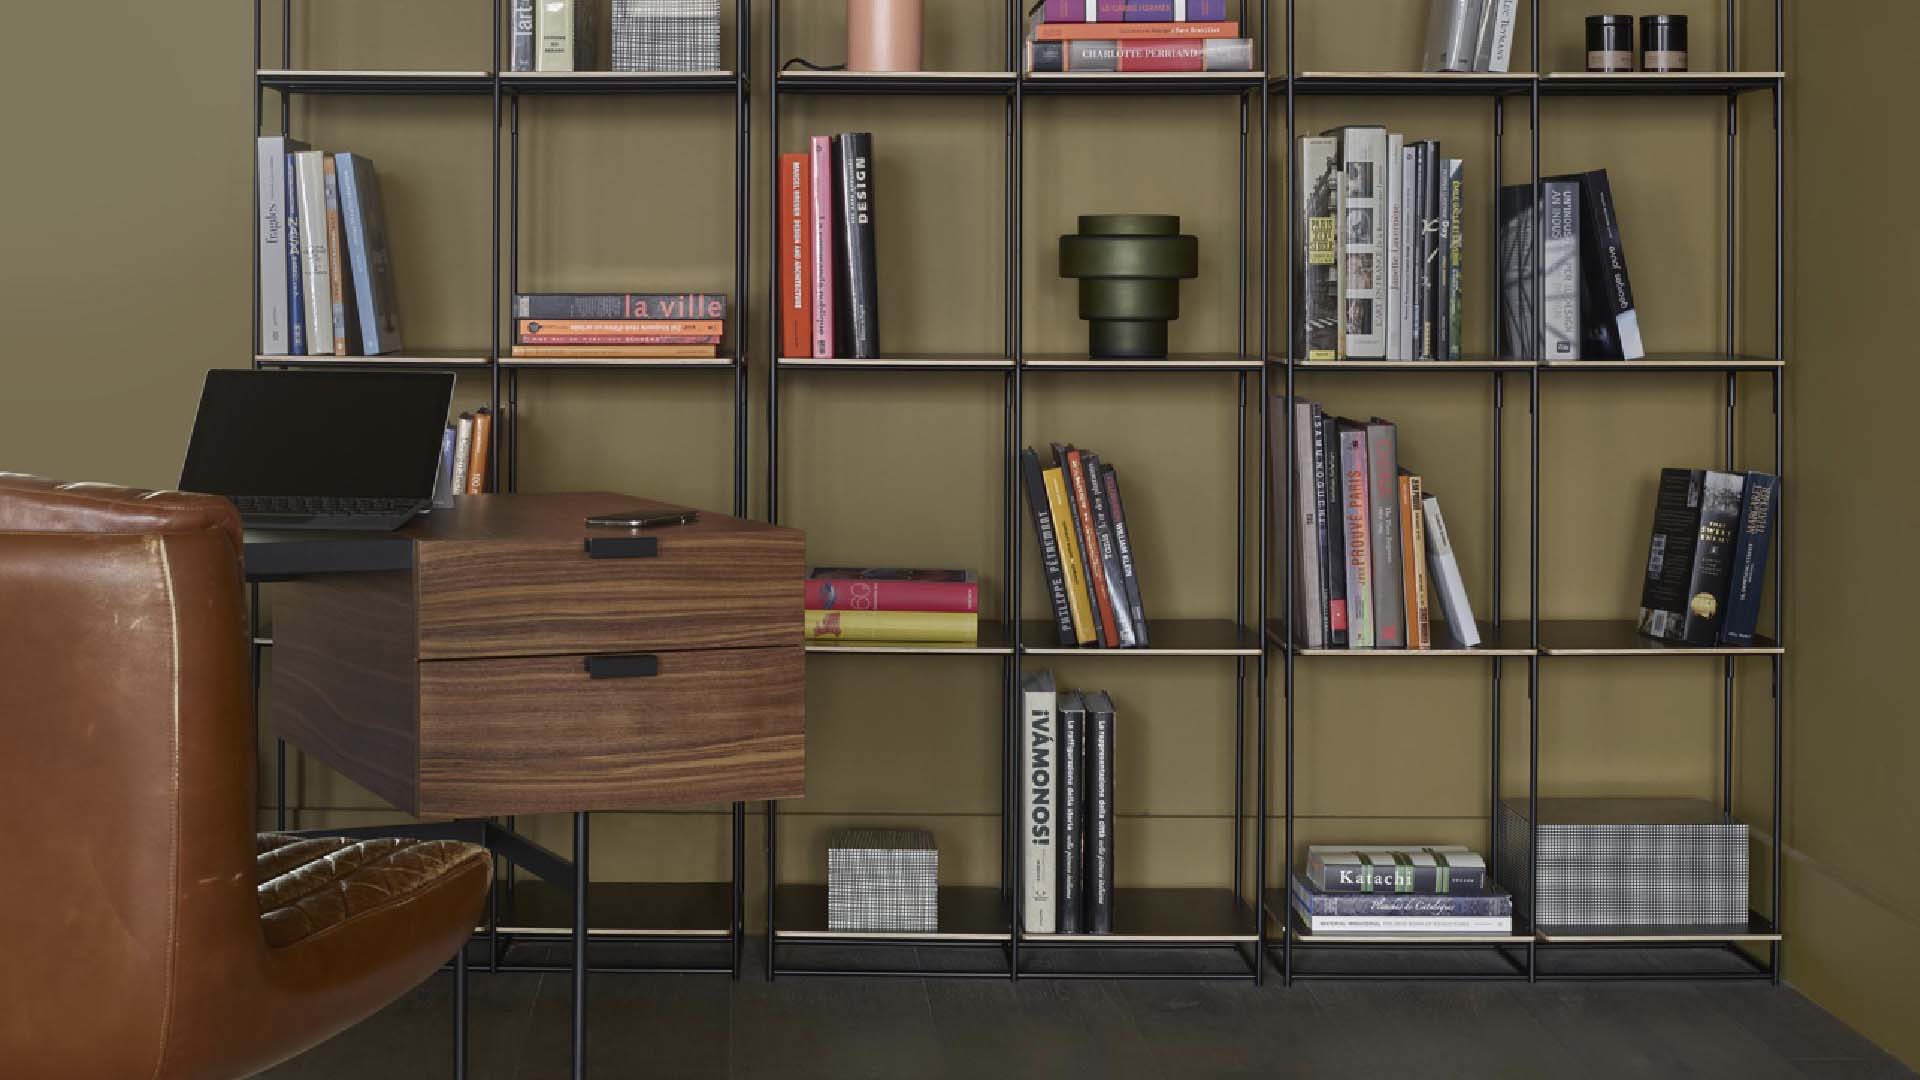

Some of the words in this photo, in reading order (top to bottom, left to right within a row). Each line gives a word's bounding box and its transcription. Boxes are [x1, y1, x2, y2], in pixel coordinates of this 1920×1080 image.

[1082, 48, 1142, 58] CHARLOTTE
[856, 157, 868, 223] DESIGN
[625, 294, 648, 317] la
[659, 294, 721, 317] ville
[1314, 414, 1324, 462] ISAMU
[1315, 462, 1326, 529] NOGUCHI
[1347, 470, 1363, 509] PARIS
[1346, 514, 1365, 566] PROUVÉ
[1052, 578, 1072, 631] PHILIPPE
[1032, 709, 1053, 845] ¡VÁMONOS!
[1339, 870, 1413, 886] Katachi
